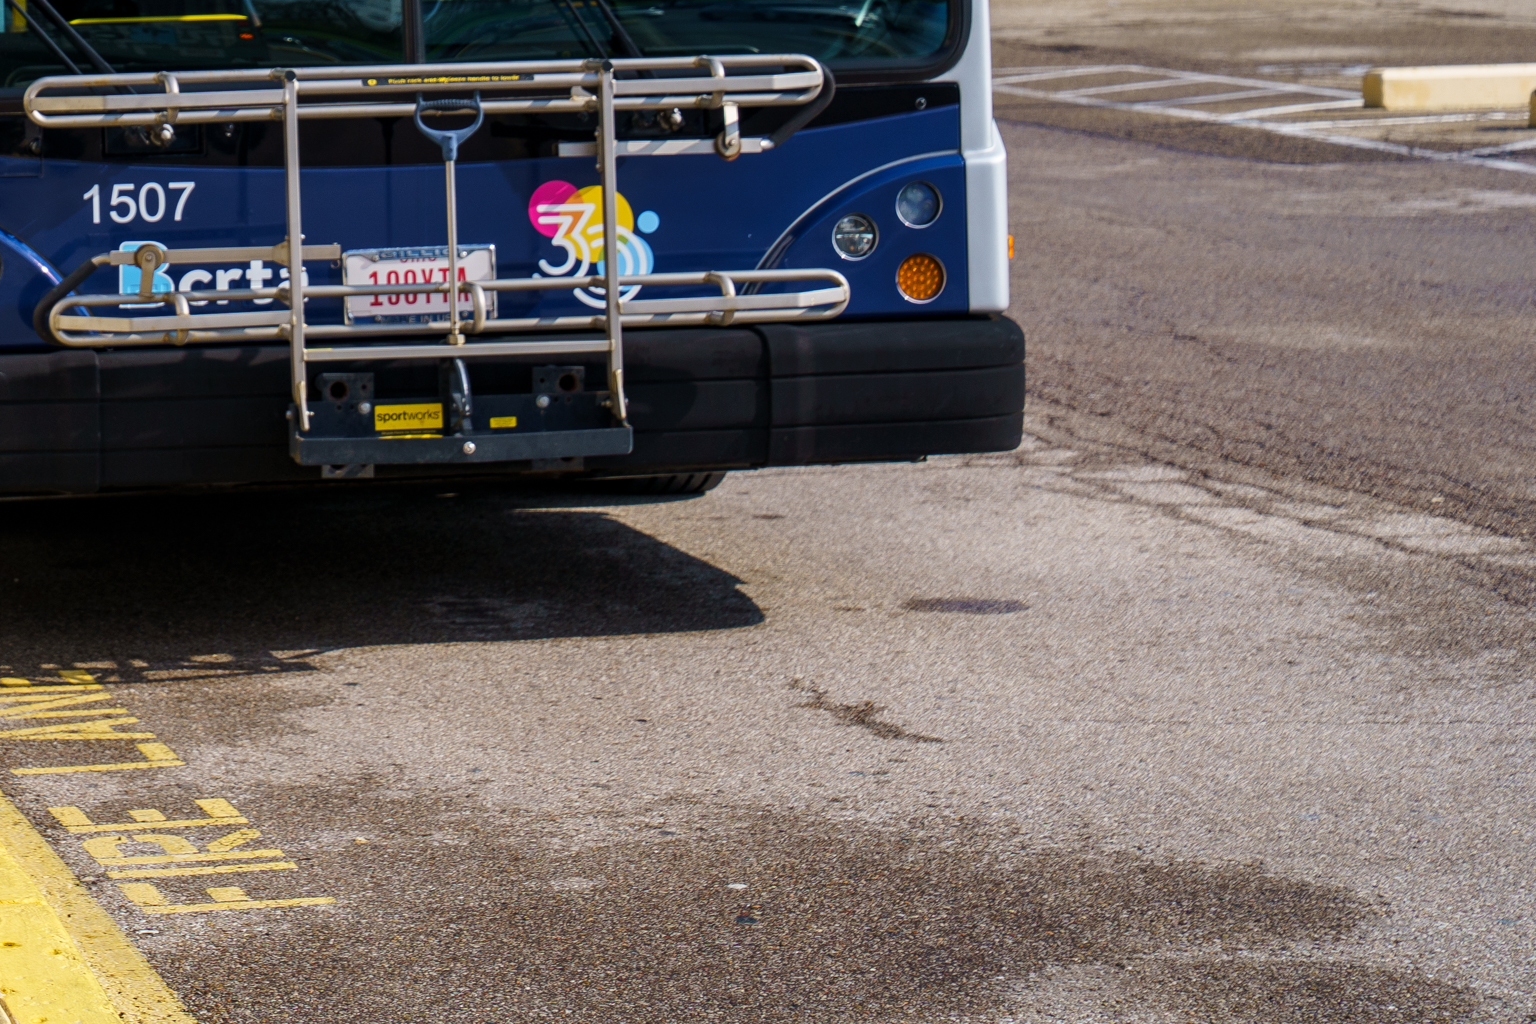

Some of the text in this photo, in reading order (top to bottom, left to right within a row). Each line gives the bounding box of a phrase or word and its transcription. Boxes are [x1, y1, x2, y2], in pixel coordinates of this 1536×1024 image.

[83, 181, 196, 224] 1507
[376, 409, 440, 424] sportworks
[47, 798, 337, 915] FIRE
